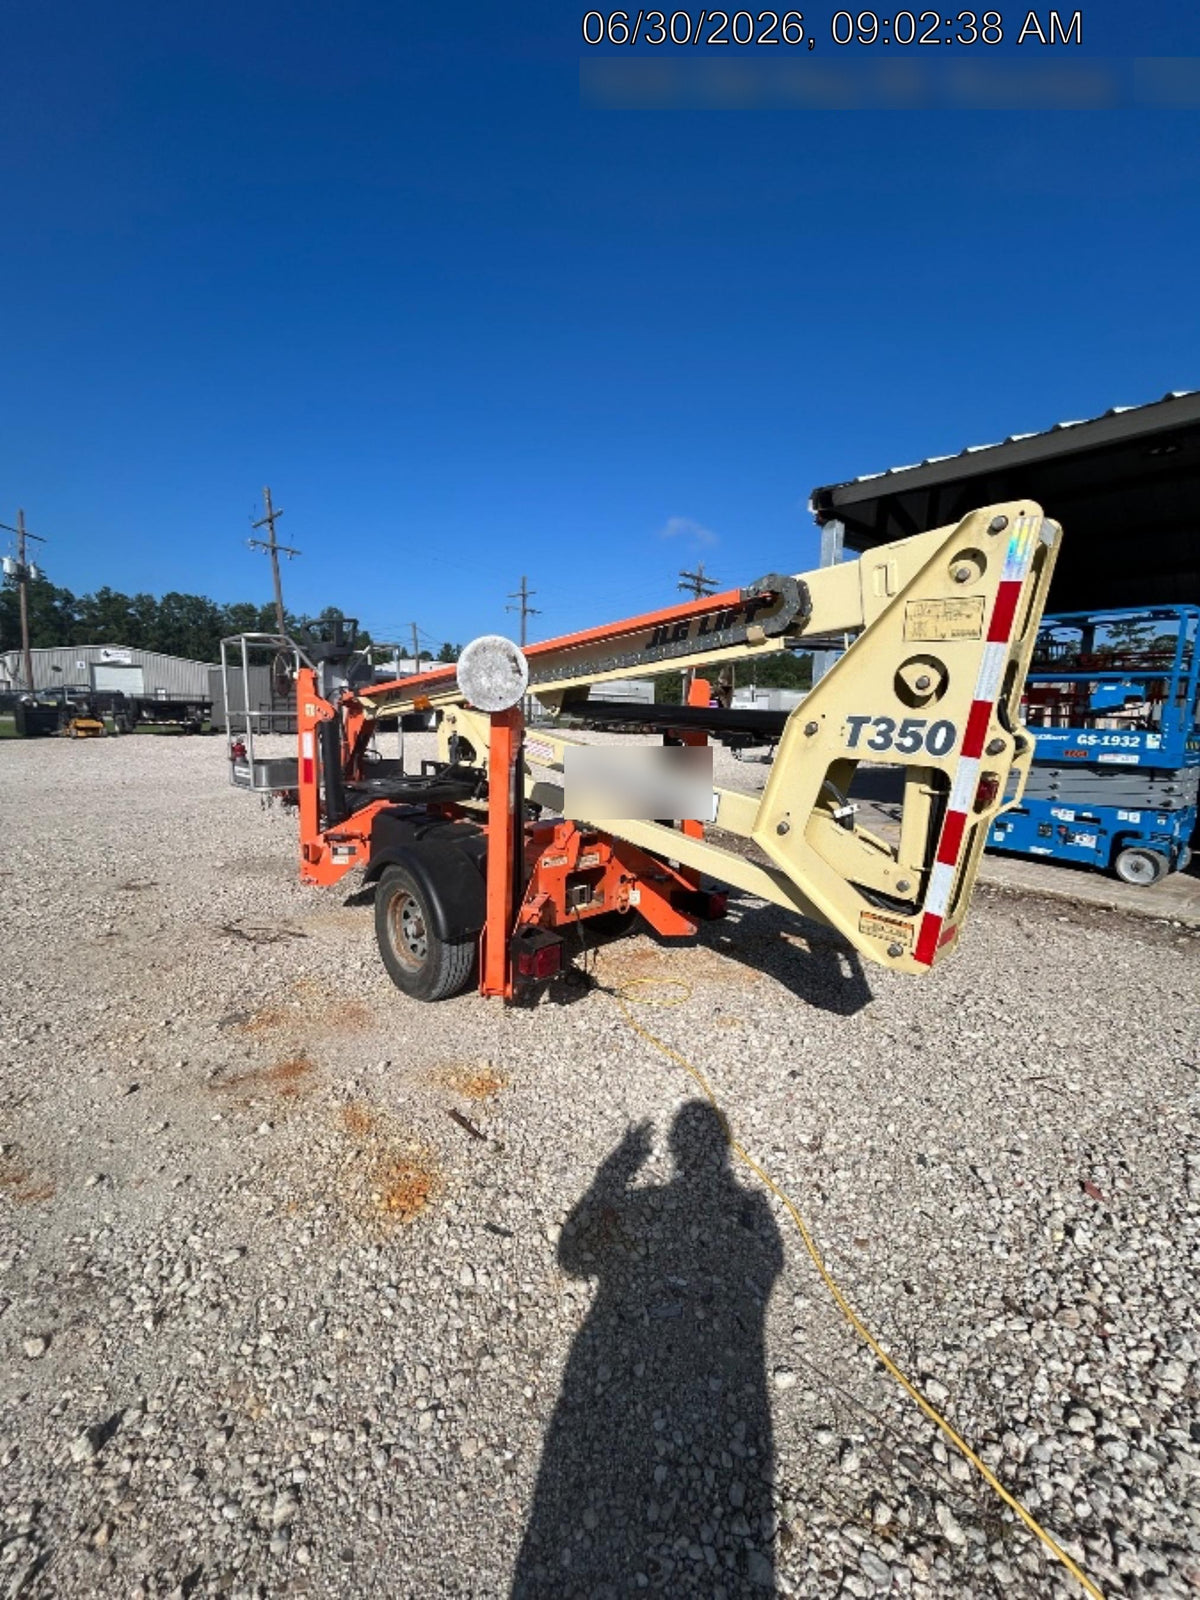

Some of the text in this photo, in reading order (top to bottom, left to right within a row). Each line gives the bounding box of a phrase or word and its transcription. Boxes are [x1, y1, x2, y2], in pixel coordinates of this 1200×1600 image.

[645, 597, 768, 649] JLG LIFT
[845, 715, 957, 757] T350
[1076, 733, 1141, 748] GS-1932
